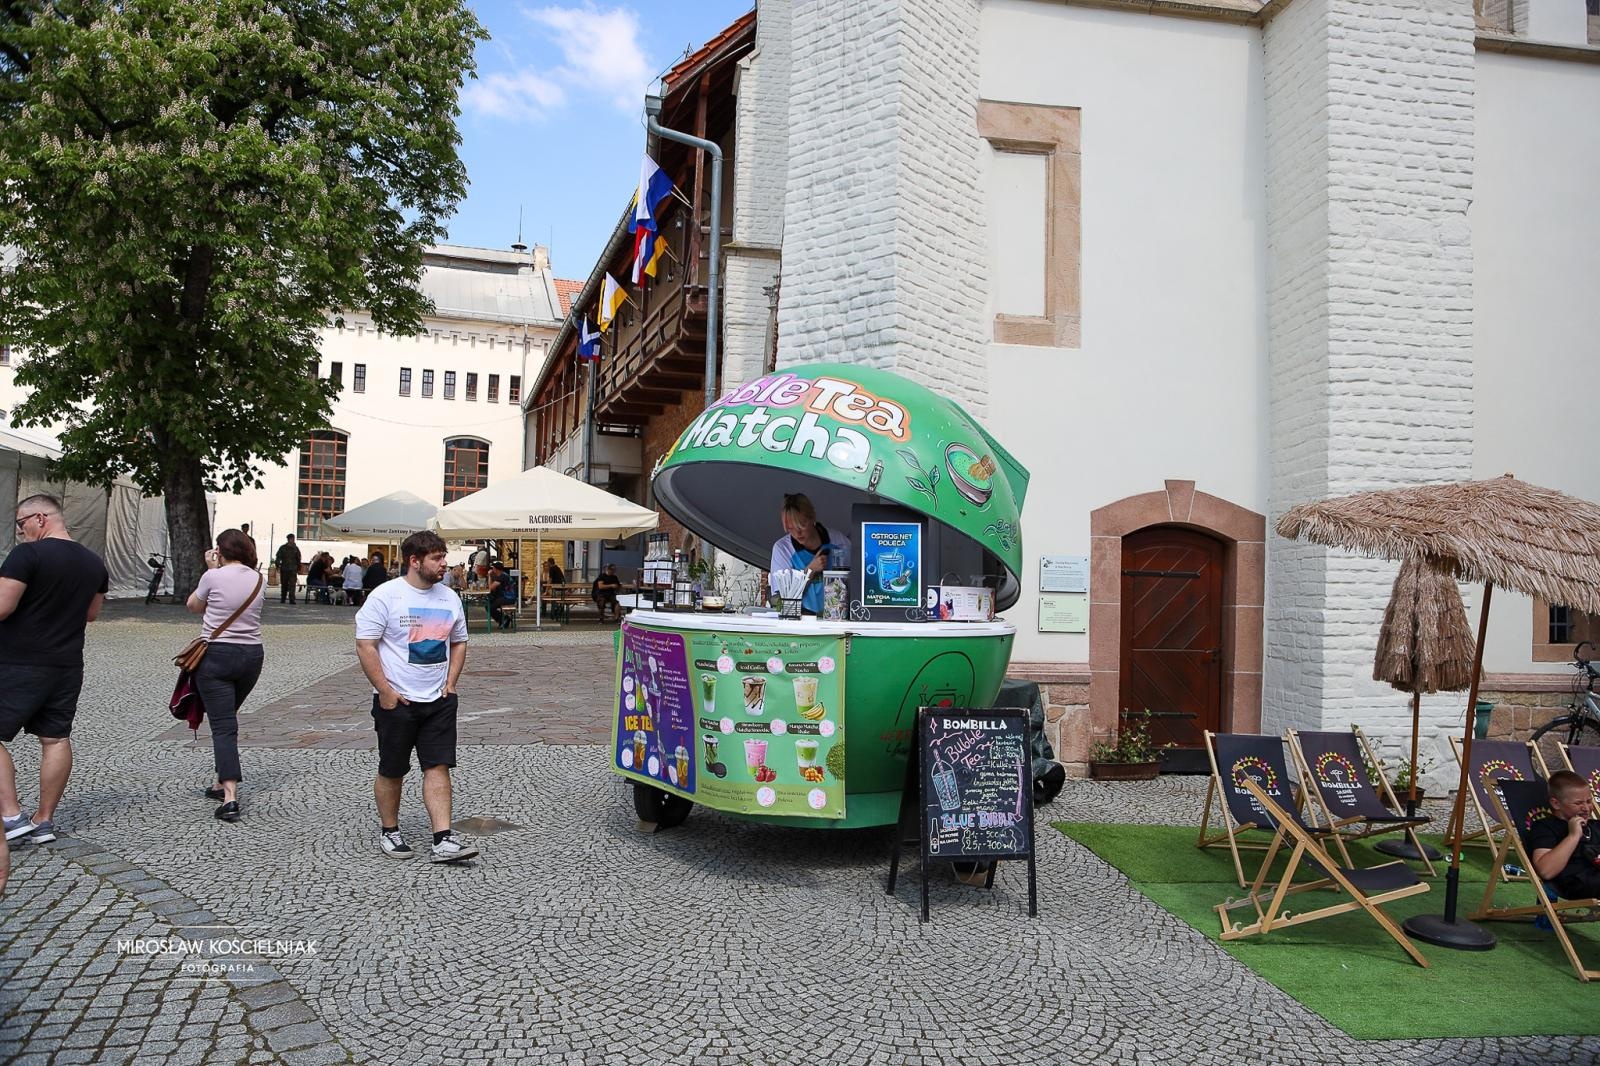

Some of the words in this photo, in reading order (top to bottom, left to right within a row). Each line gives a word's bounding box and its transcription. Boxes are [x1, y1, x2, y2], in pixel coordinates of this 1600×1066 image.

[811, 378, 905, 438] Tea
[679, 407, 871, 473] Matcha
[529, 515, 573, 524] RACIBORSKIE
[624, 715, 639, 731] ICE
[943, 719, 1008, 730] BOMBILLA
[945, 729, 985, 764] Bubble
[961, 753, 986, 769] Tea
[1321, 781, 1363, 789] BOMBILLA
[941, 812, 976, 829] BLUE
